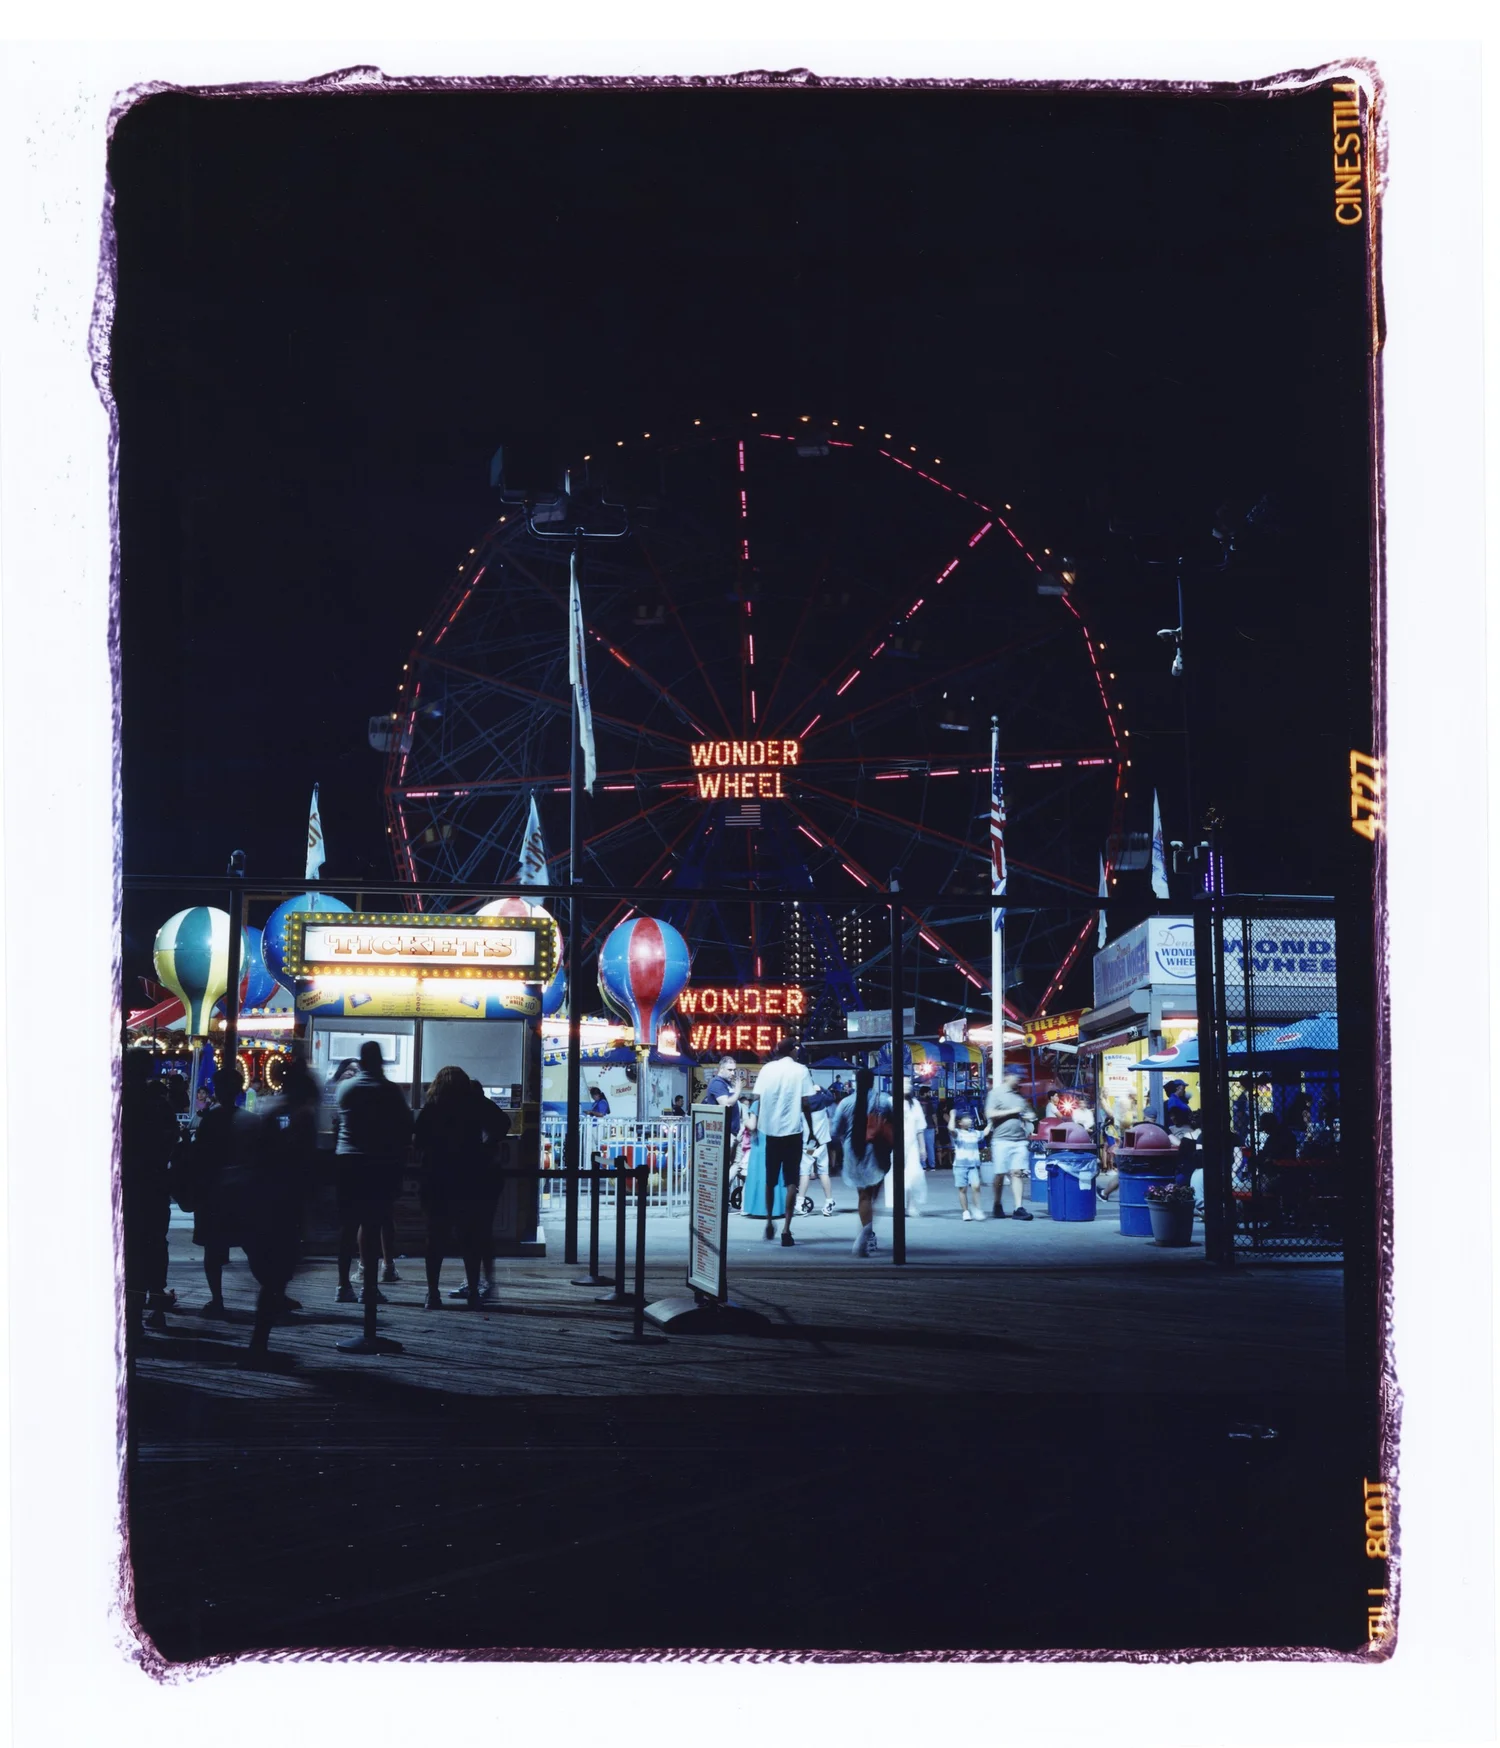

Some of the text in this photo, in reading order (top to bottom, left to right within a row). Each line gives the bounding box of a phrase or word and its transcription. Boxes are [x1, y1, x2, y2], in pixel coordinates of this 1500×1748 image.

[691, 740, 798, 767] WONDER
[698, 772, 787, 798] WHEEL
[1350, 749, 1381, 841] 4727
[328, 934, 513, 958] TICKETS
[1223, 939, 1337, 954] WOND
[679, 988, 804, 1014] WONDER
